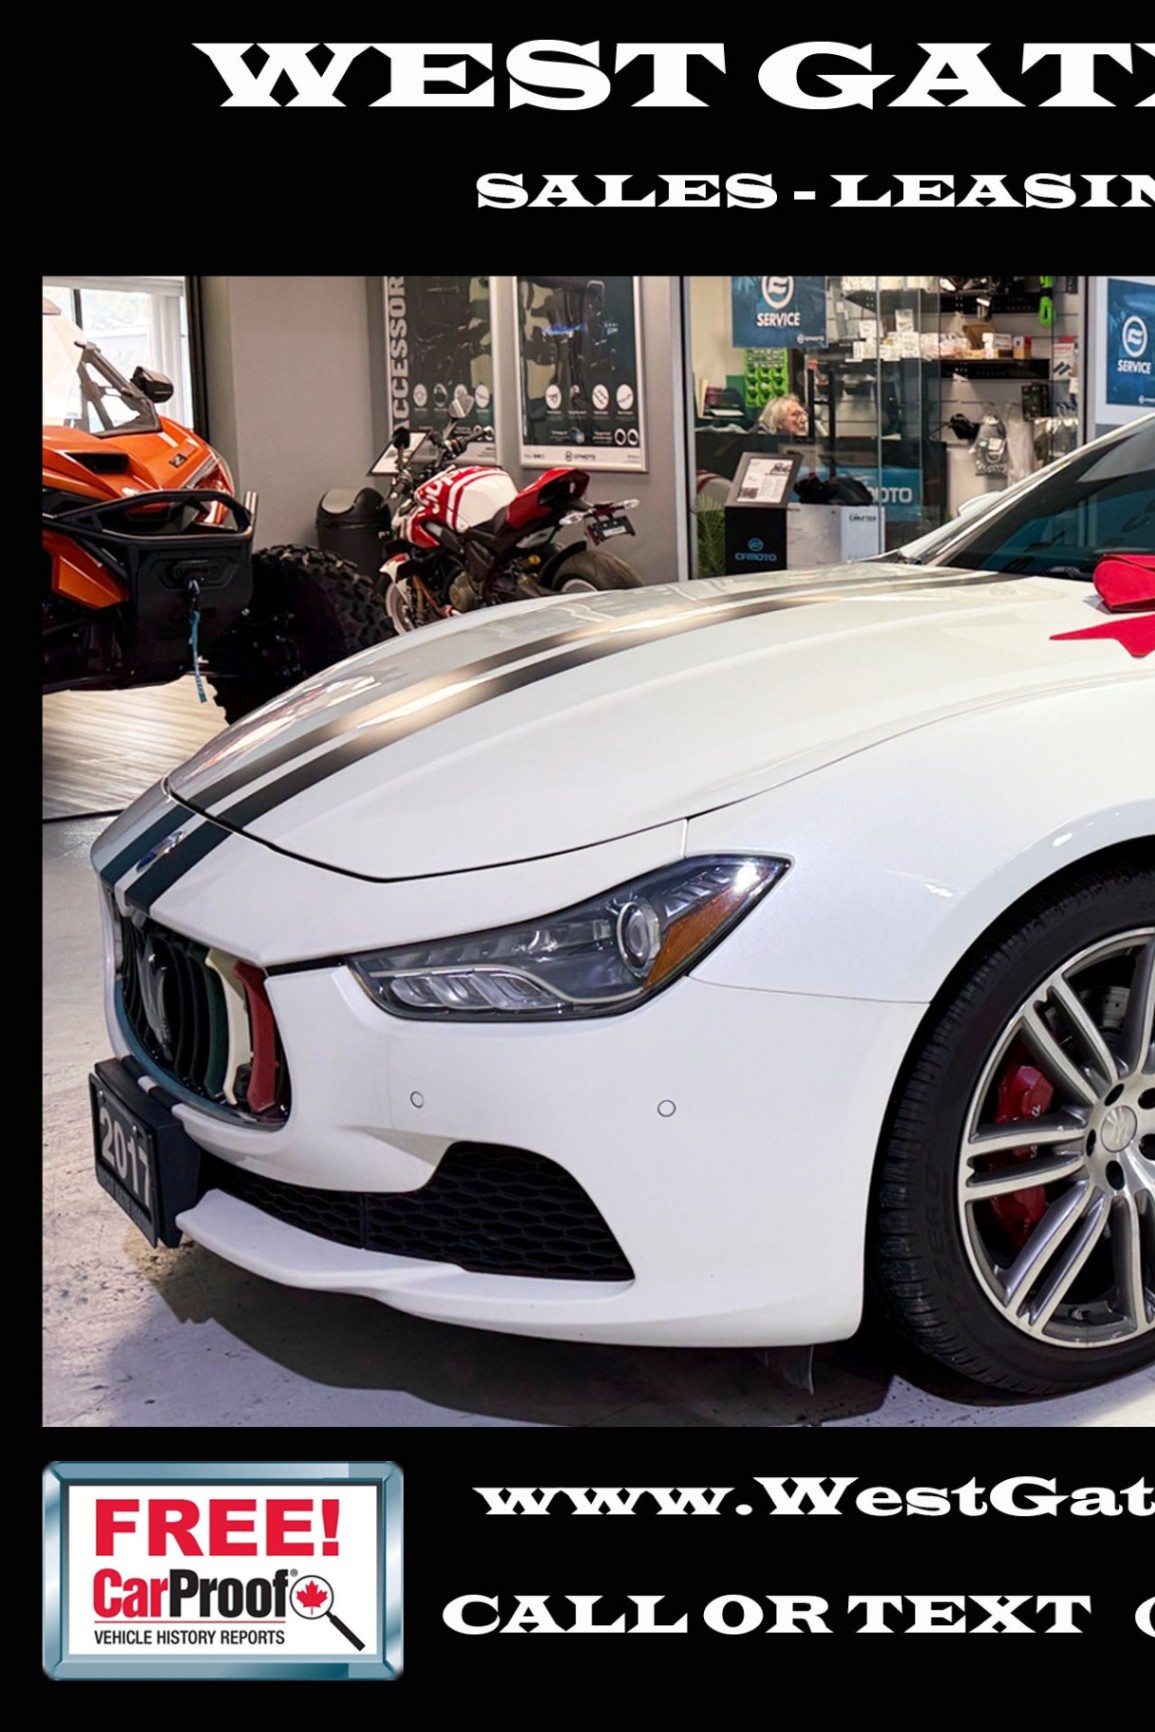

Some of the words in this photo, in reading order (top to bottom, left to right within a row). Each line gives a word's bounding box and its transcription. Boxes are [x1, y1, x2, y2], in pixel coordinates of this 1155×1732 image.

[757, 312, 801, 327] SERVICE
[1117, 359, 1152, 374] SERVICE
[866, 486, 912, 503] MOTO
